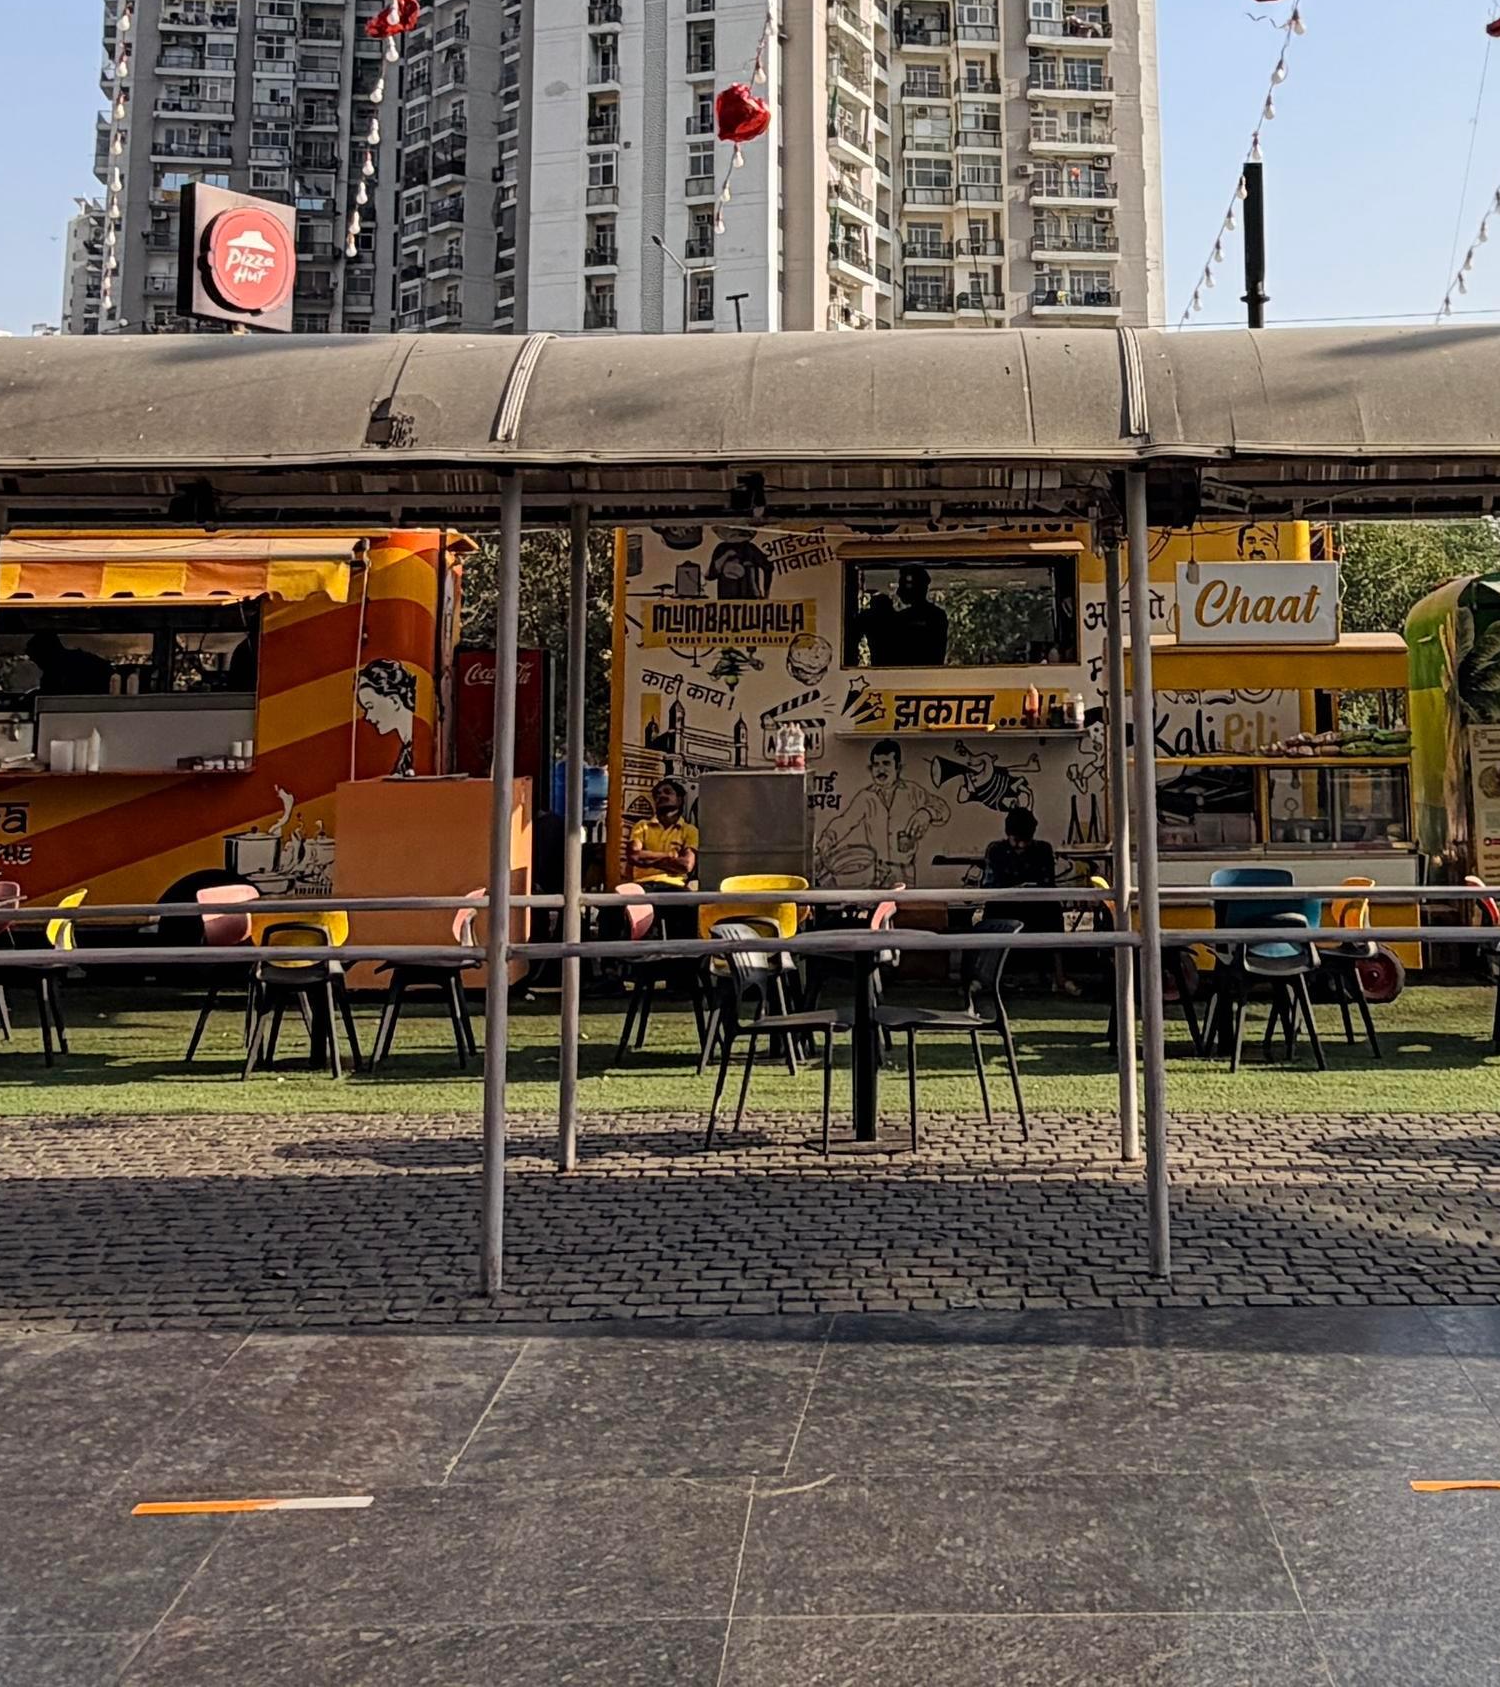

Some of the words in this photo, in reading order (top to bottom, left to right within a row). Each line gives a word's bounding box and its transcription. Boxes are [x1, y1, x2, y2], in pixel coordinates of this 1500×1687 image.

[225, 248, 276, 272] Pizza
[233, 265, 269, 285] Hut
[653, 602, 804, 634] MUMBAIWALLA
[1194, 579, 1322, 628] Chaat
[642, 668, 684, 698] काही
[894, 695, 995, 731] झकास
[1154, 709, 1217, 758] Kali
[1223, 712, 1280, 750] Pili
